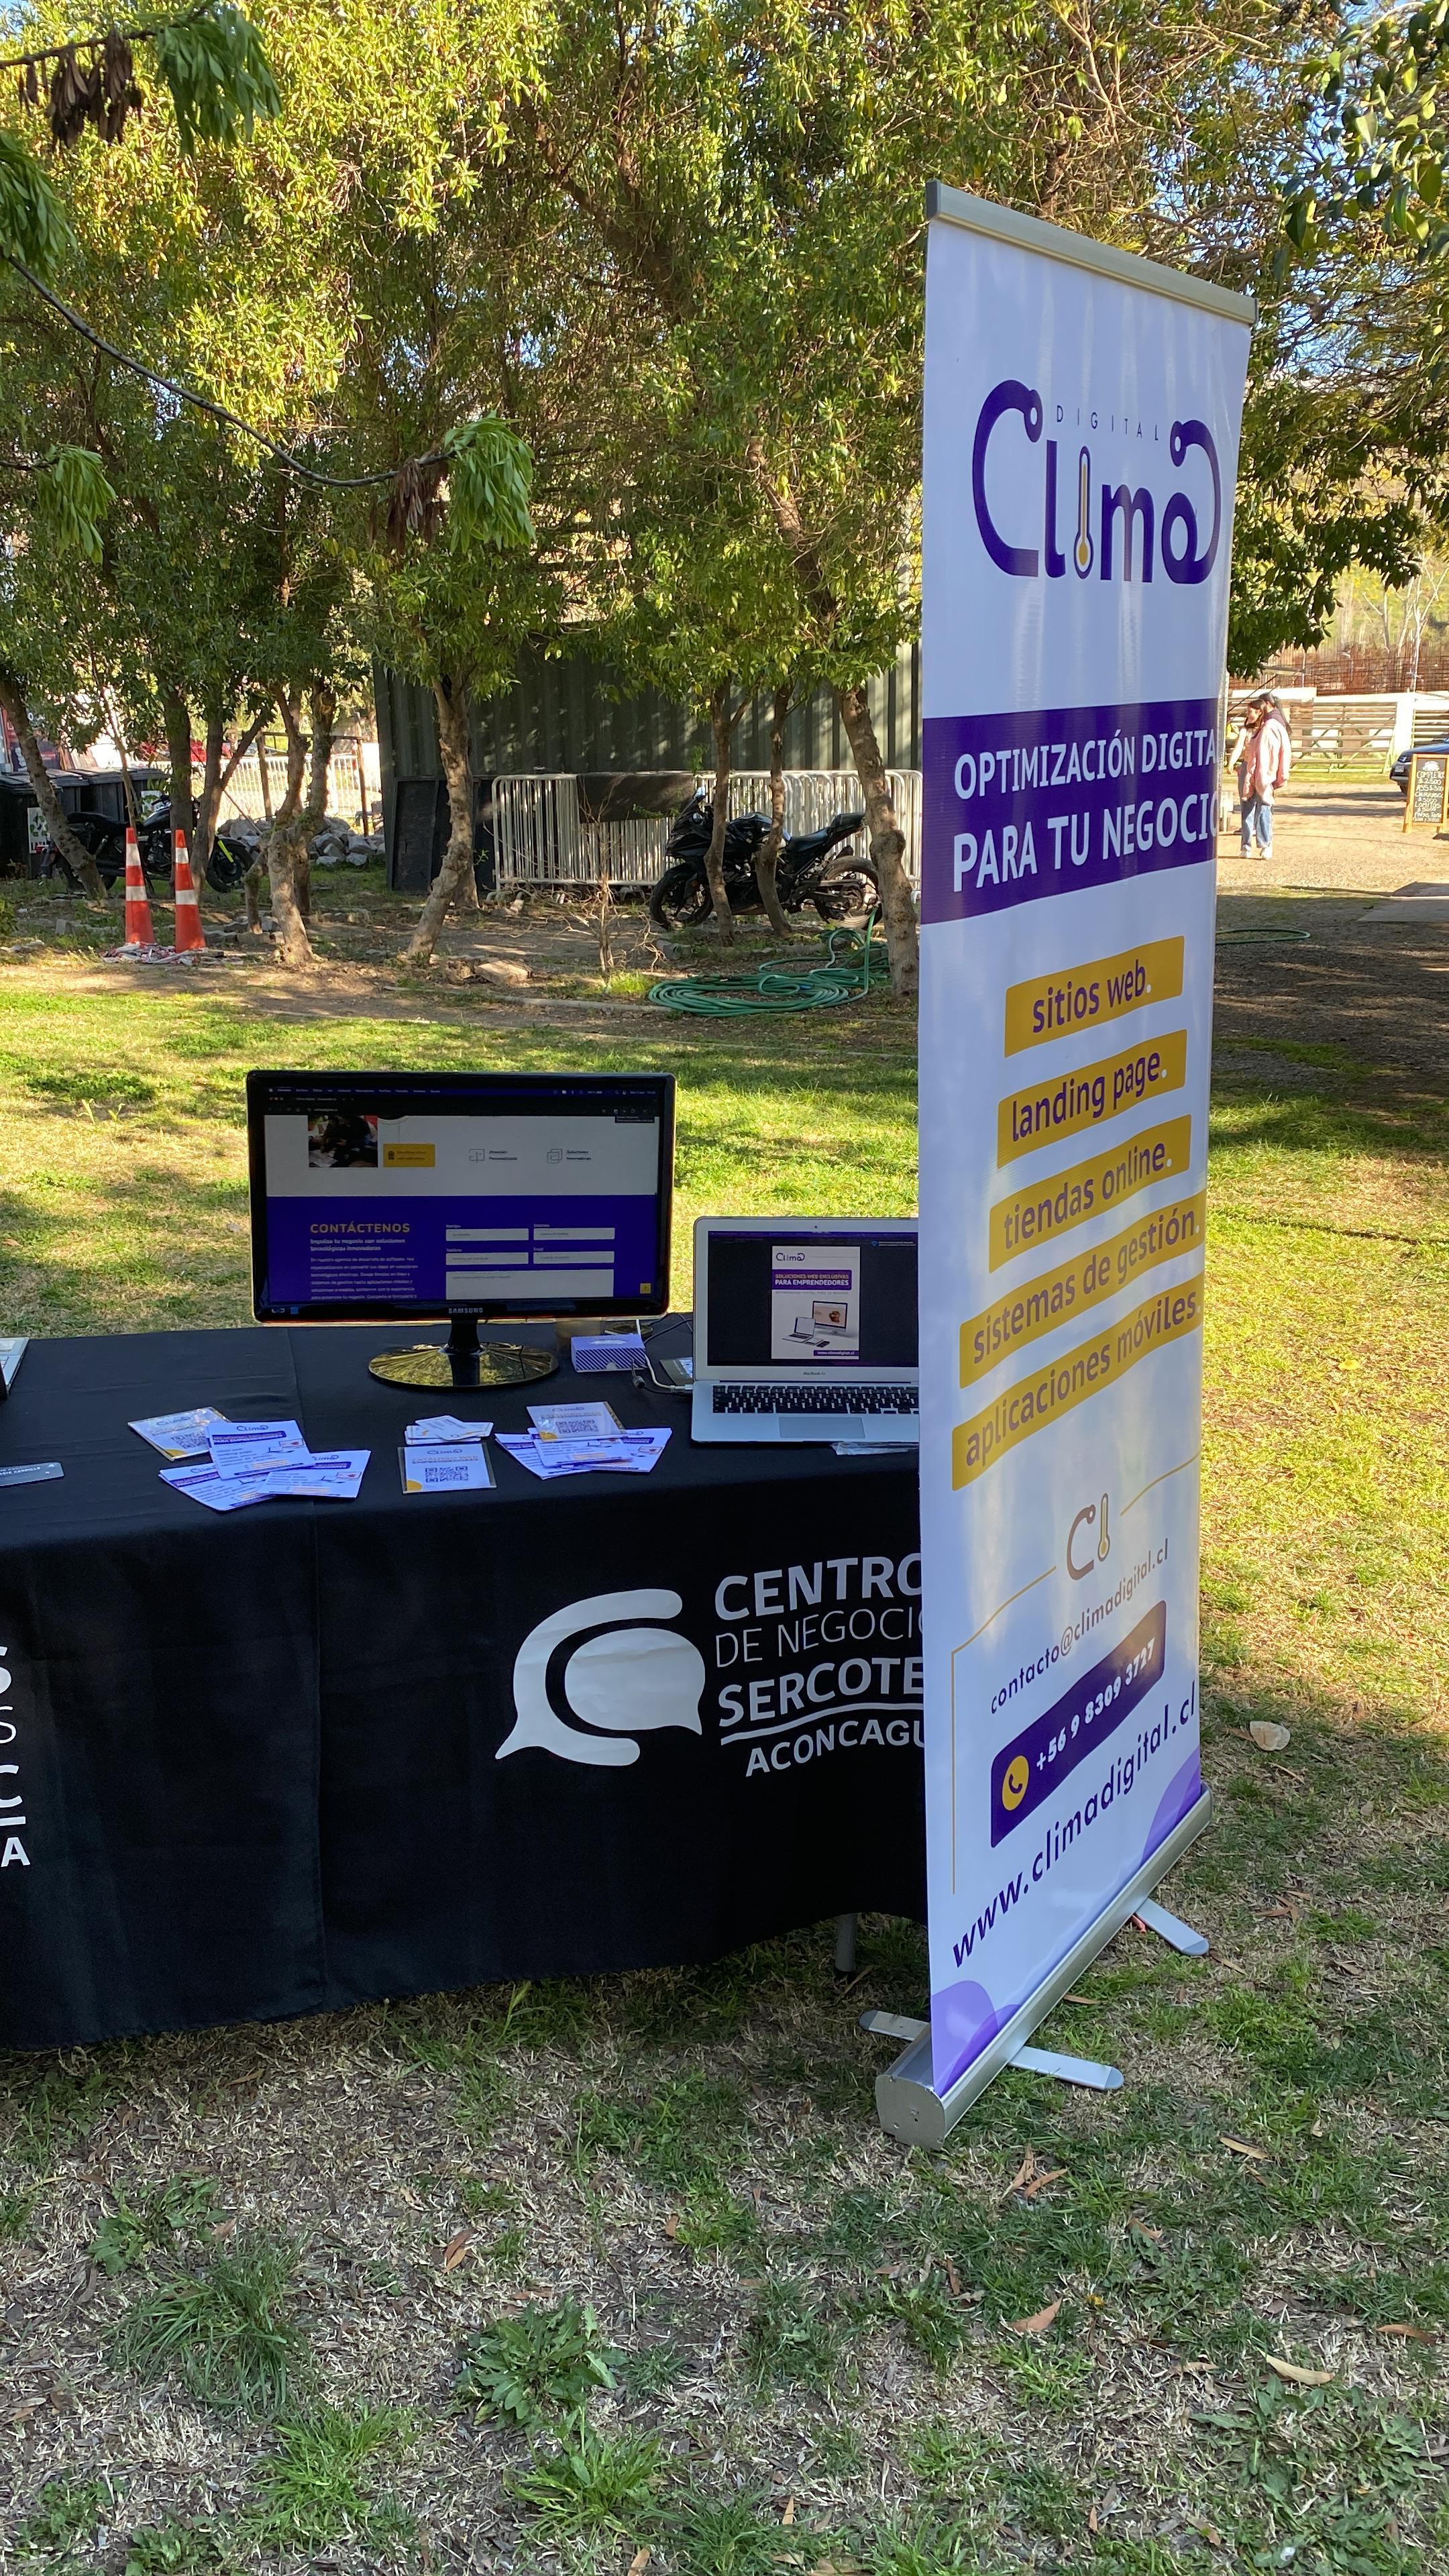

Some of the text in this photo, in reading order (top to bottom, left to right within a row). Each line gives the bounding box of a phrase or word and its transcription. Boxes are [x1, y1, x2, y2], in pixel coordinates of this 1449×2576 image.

[1056, 405, 1159, 441] DIGITAL
[954, 729, 1136, 800] OPTIMIZACIÓN
[953, 820, 1038, 893] PARA
[1048, 812, 1089, 871] TU
[1032, 959, 1152, 1034] sitios web.
[1012, 1049, 1167, 1142] landing page.
[310, 1221, 411, 1234] CONTÁCTENOS
[1004, 1140, 1173, 1250] tiendas online.
[973, 1207, 1199, 1364] sistemas de gestión.
[966, 1343, 1111, 1467] aplicaciones
[715, 1627, 763, 1668] DE
[990, 1538, 1169, 1715] contacto@climadigital.cl
[1035, 1637, 1156, 1772] +56 9 8309 3727
[951, 1680, 1197, 1969] www.climadigital.cl
